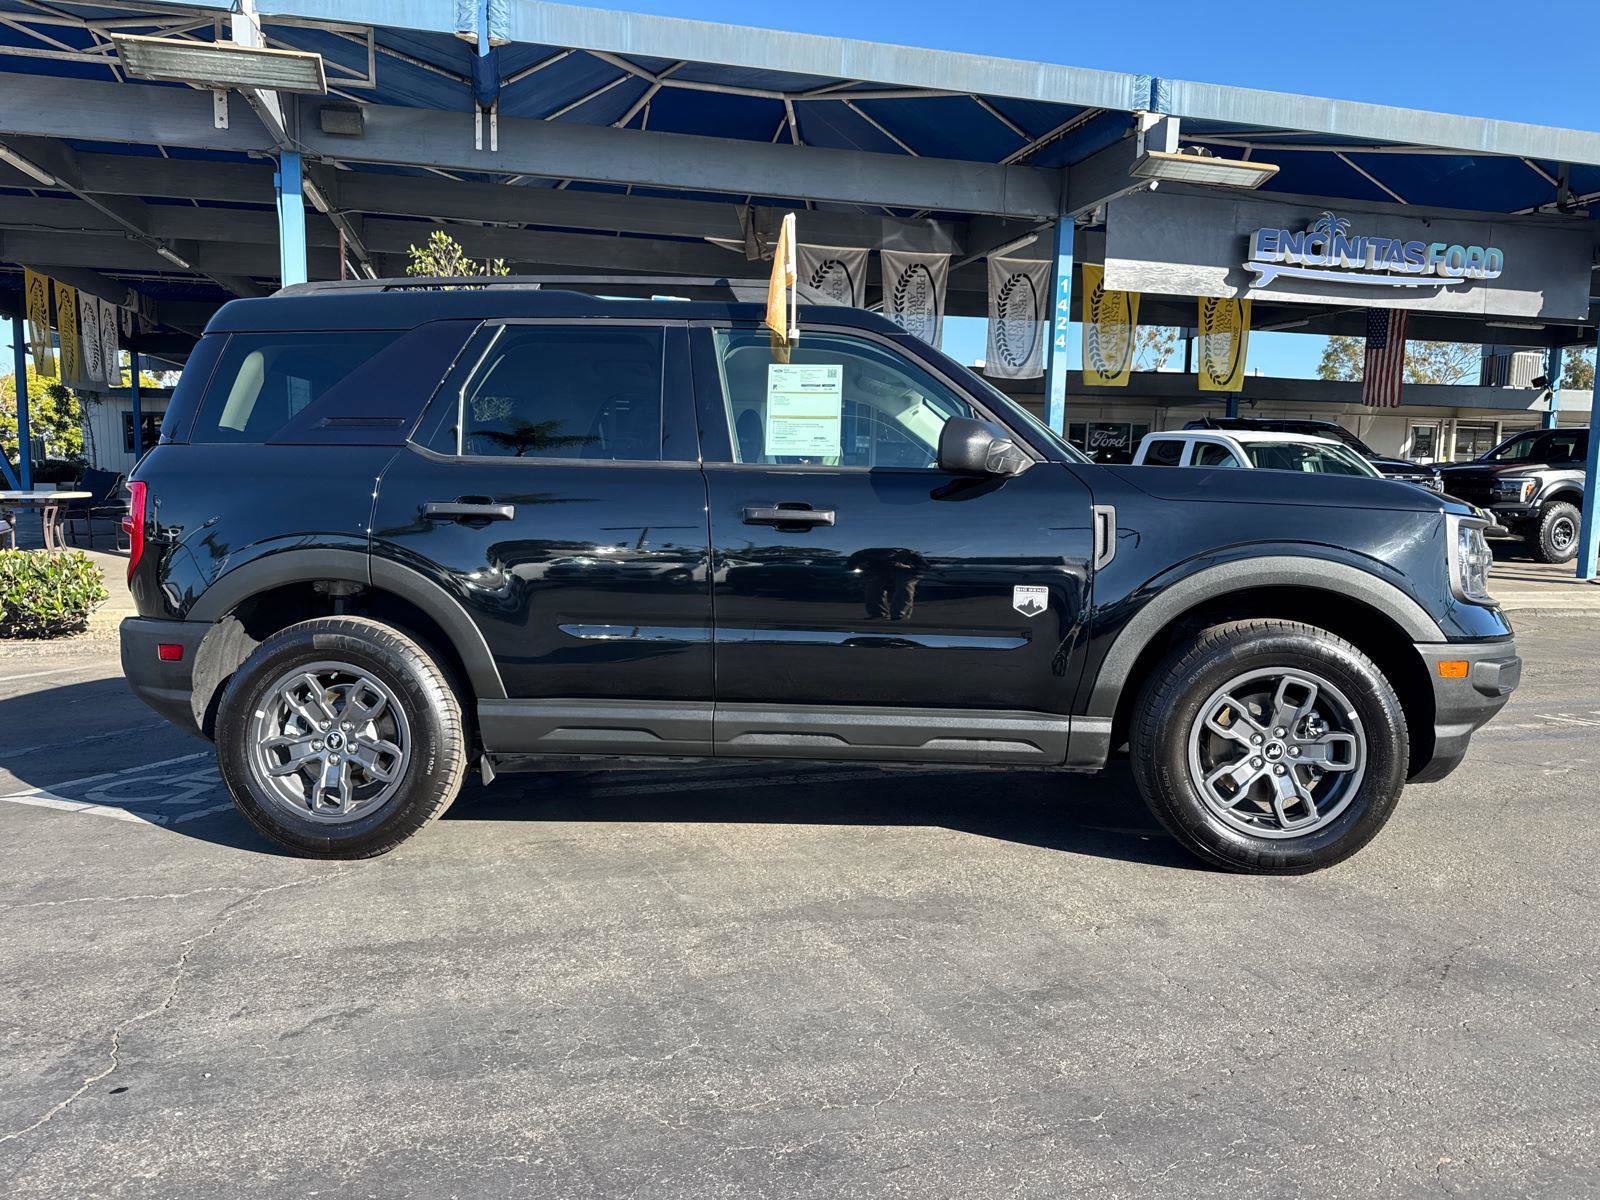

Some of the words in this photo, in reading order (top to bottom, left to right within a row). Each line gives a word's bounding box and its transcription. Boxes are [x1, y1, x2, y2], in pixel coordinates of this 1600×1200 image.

[1250, 226, 1427, 273] ENCINITAS
[1427, 242, 1504, 279] FORD
[1007, 301, 1018, 341] AWARD
[1056, 278, 1069, 349] 1424
[1100, 302, 1111, 350] AWARD
[1213, 309, 1224, 357] AWARD
[1090, 429, 1128, 447] Ford
